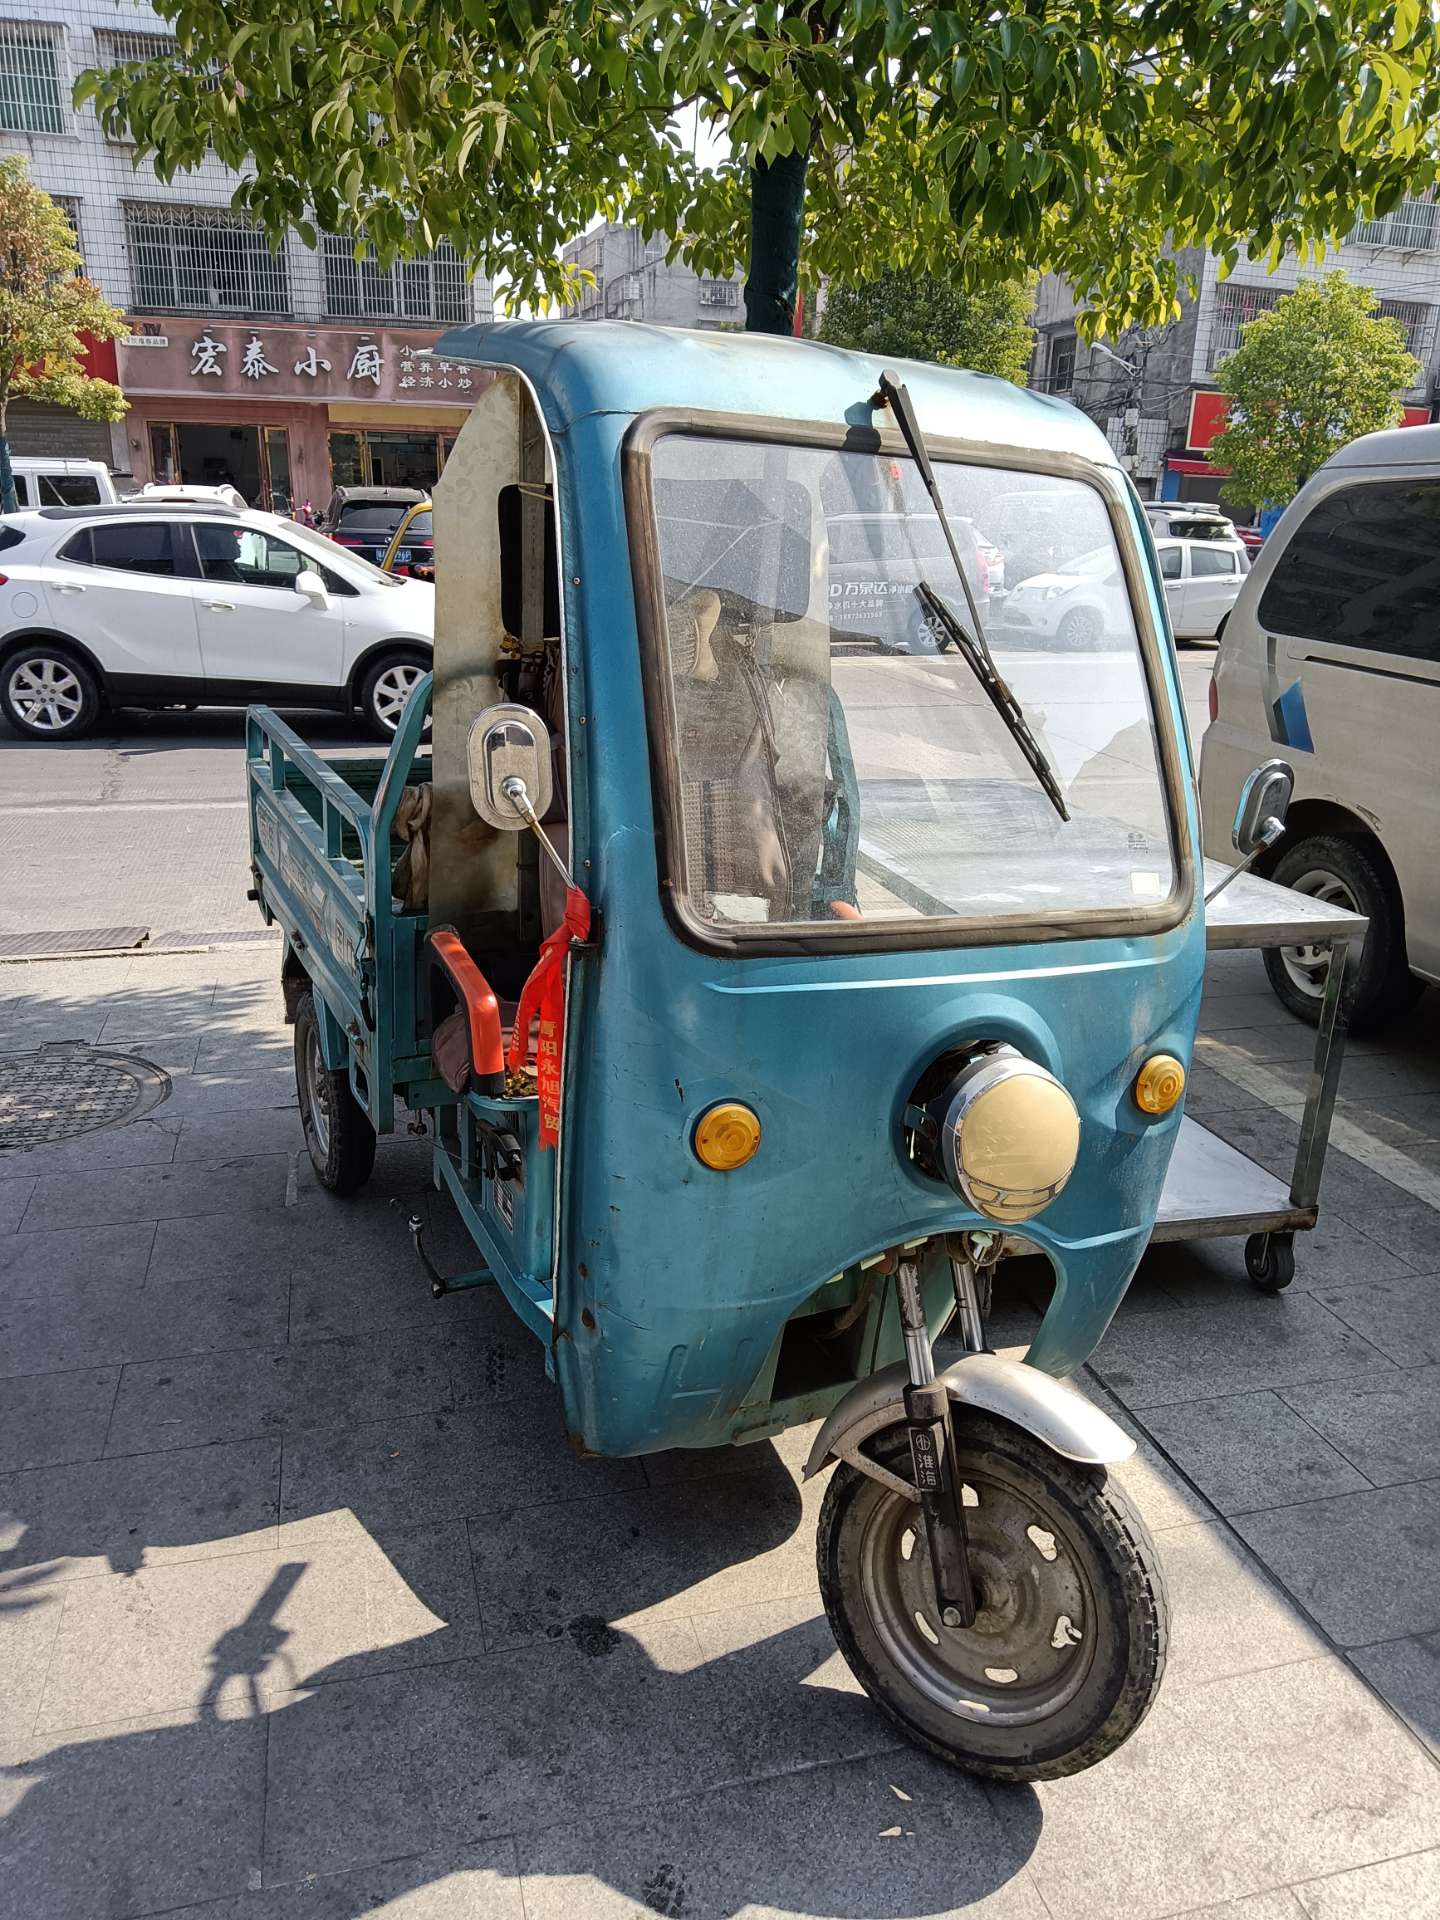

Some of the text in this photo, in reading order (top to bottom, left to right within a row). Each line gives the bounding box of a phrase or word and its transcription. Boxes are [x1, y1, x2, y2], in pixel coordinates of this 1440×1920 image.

[191, 336, 384, 386] 宏泰小厨
[399, 376, 472, 388] 经济小炒
[917, 1453, 937, 1486] 淮海
